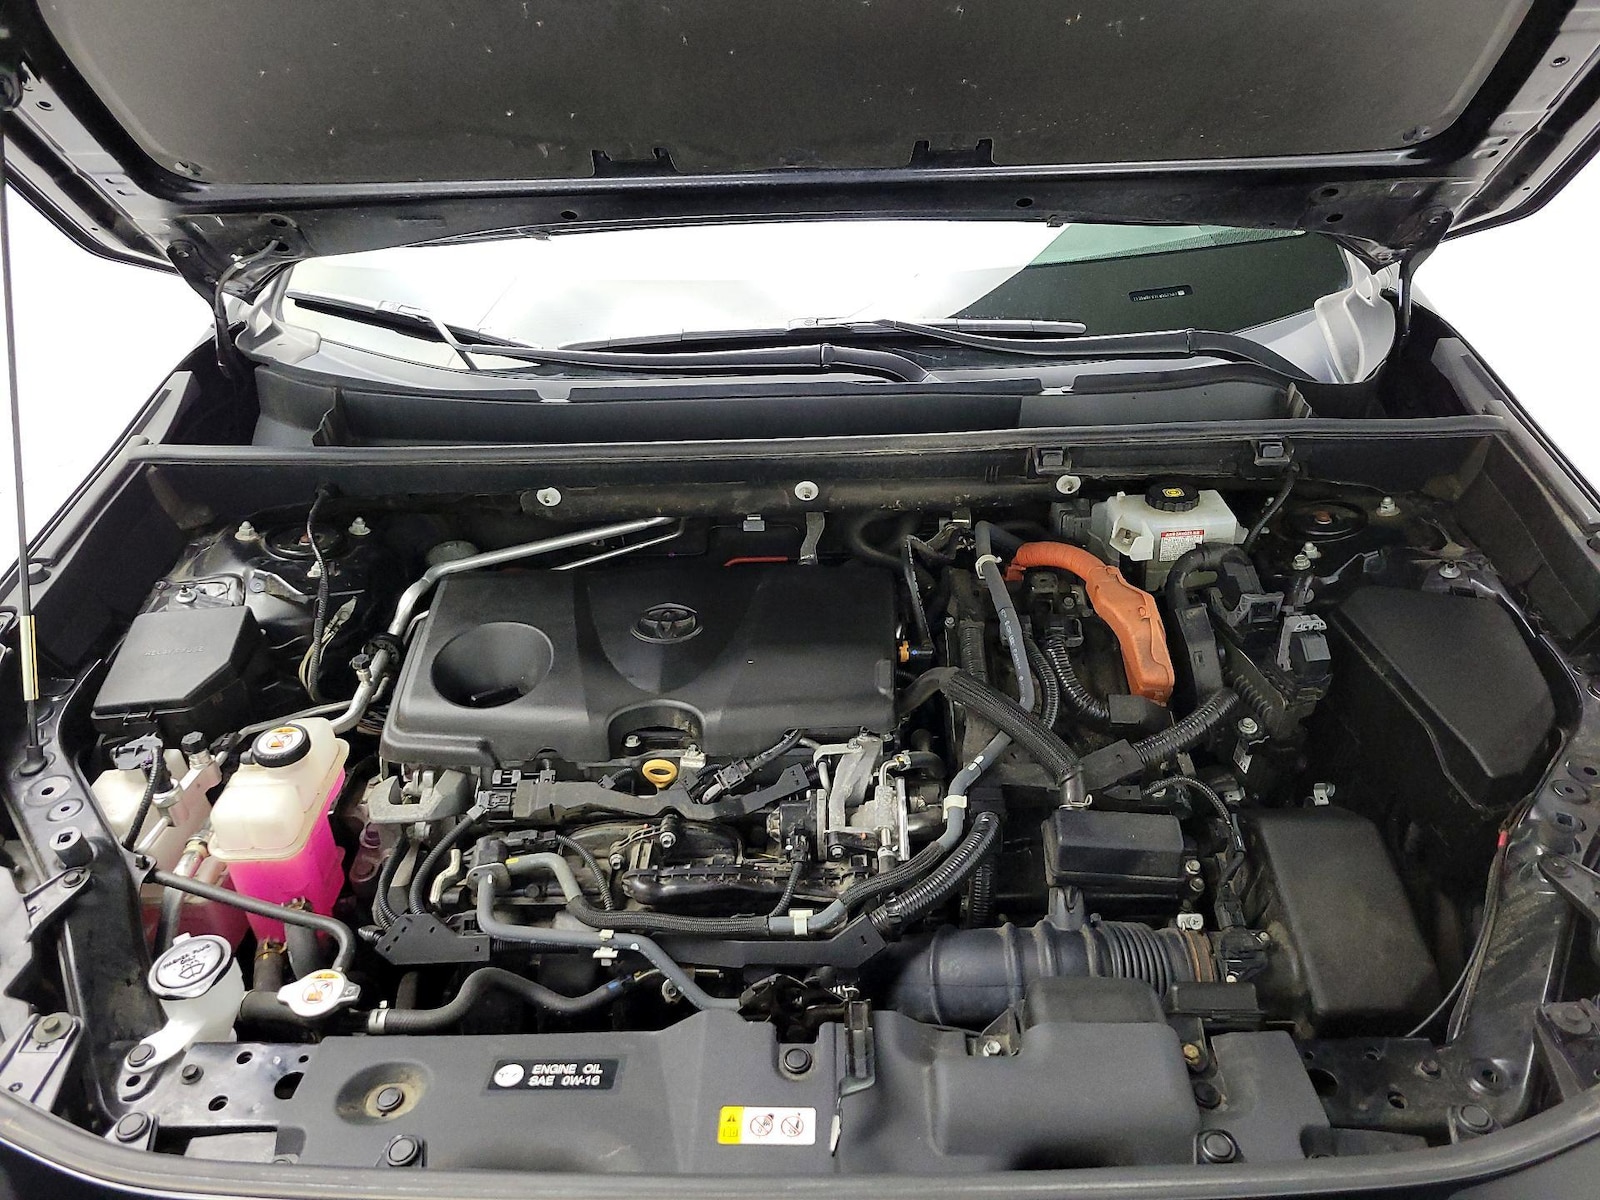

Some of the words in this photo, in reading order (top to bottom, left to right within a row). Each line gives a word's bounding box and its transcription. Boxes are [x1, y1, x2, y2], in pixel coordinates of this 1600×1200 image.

[531, 1063, 578, 1075] ENGINE
[582, 1063, 603, 1075] OIL
[527, 1075, 556, 1086] SAE
[561, 1075, 601, 1086] 0W-16
